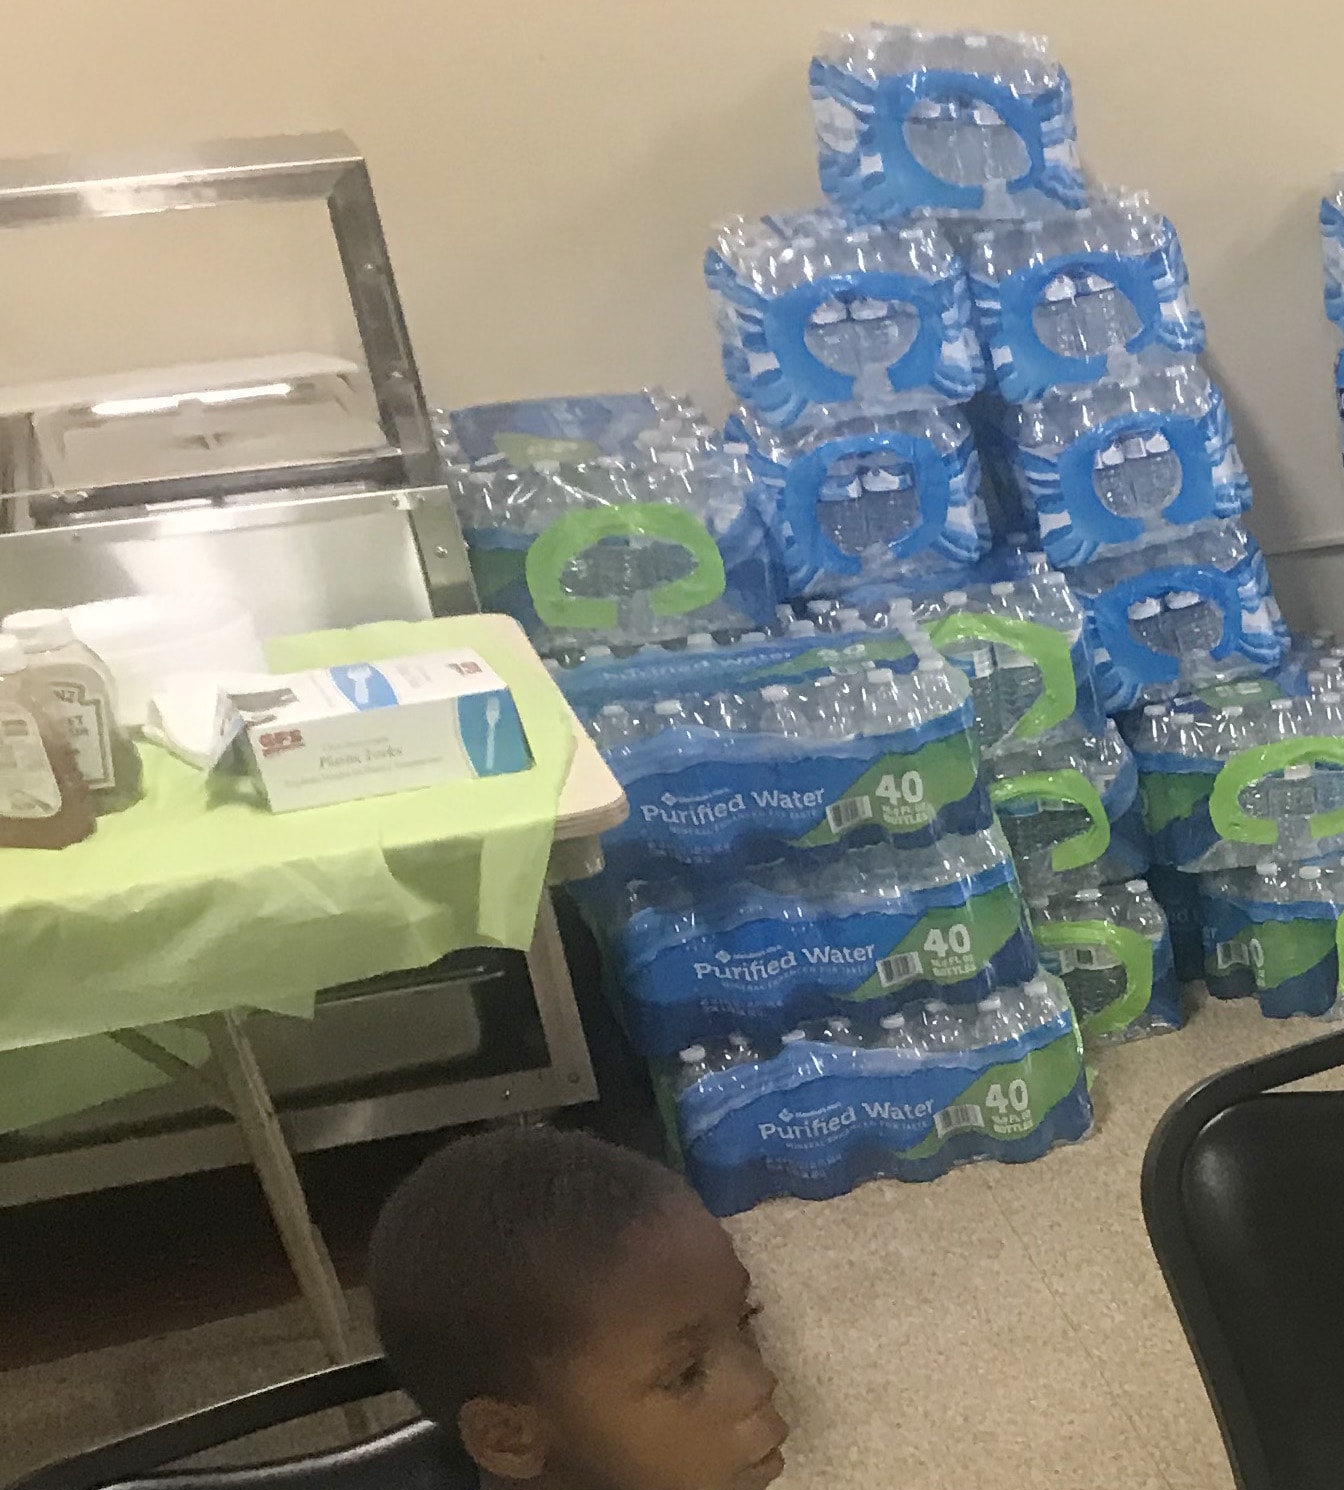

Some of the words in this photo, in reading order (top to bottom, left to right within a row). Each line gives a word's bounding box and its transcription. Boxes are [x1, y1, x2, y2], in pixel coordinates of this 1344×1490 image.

[640, 793, 746, 826] Purified
[750, 787, 824, 810] Water
[875, 770, 923, 806] 40
[923, 923, 971, 958] 40
[693, 950, 798, 982] Purified
[801, 943, 875, 965] Water
[985, 1078, 1029, 1115] 40
[758, 1106, 857, 1141] Purified
[861, 1098, 935, 1121] Water
